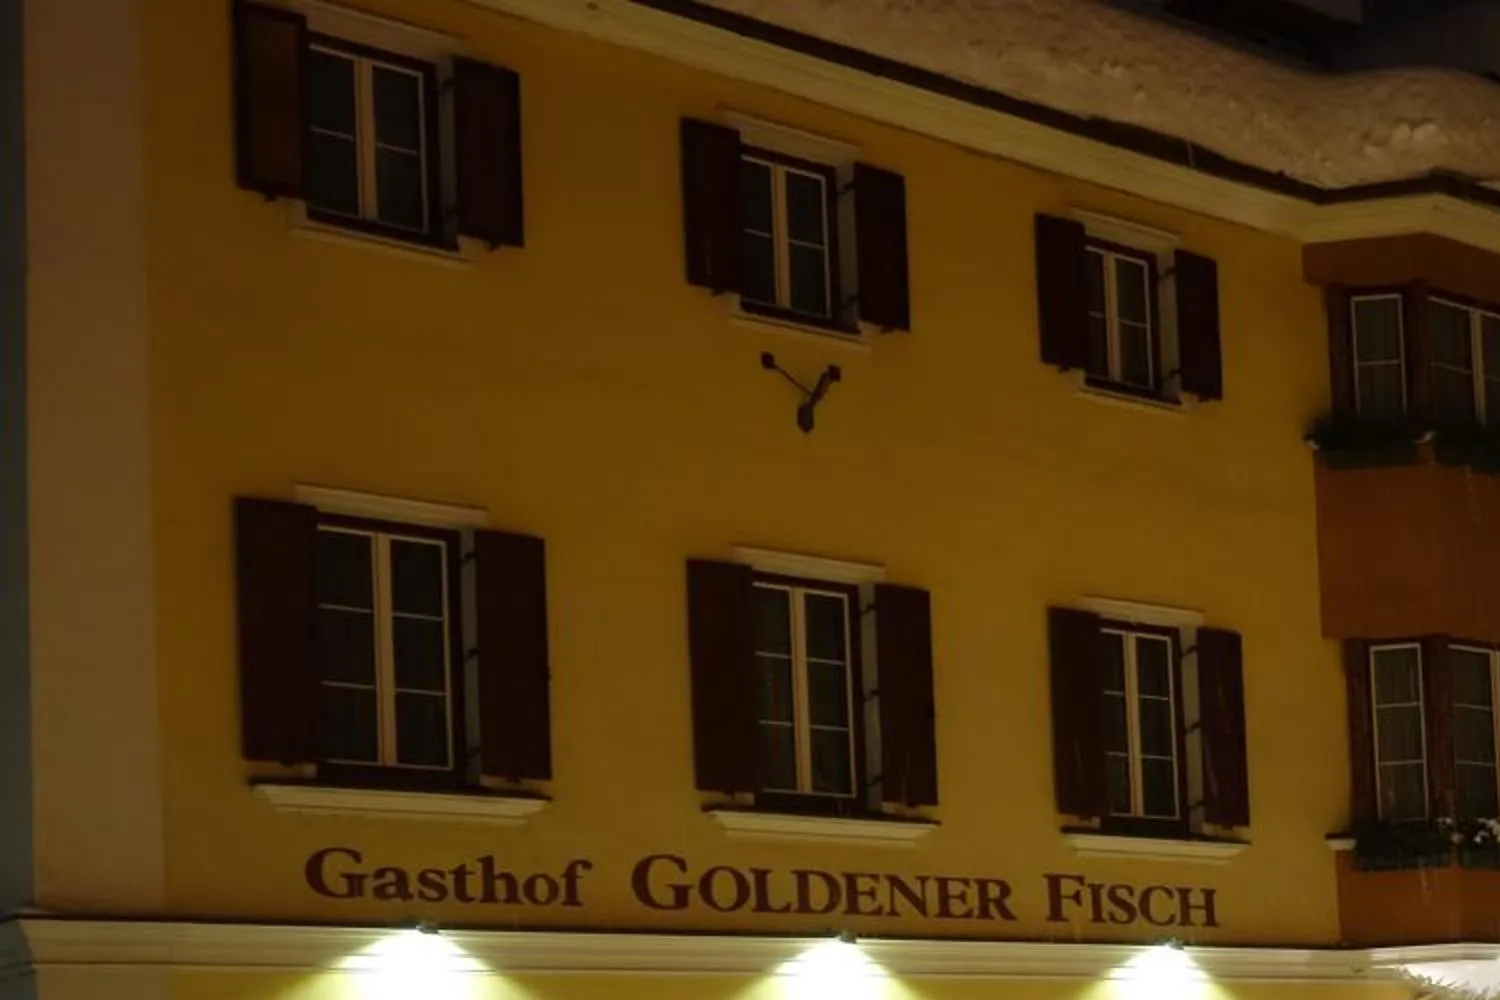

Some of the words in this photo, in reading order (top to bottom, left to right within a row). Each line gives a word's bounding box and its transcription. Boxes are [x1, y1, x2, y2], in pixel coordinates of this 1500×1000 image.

[304, 847, 593, 907] Gasthof
[631, 853, 1018, 921] GOLDENER
[1042, 872, 1221, 927] FISCH
